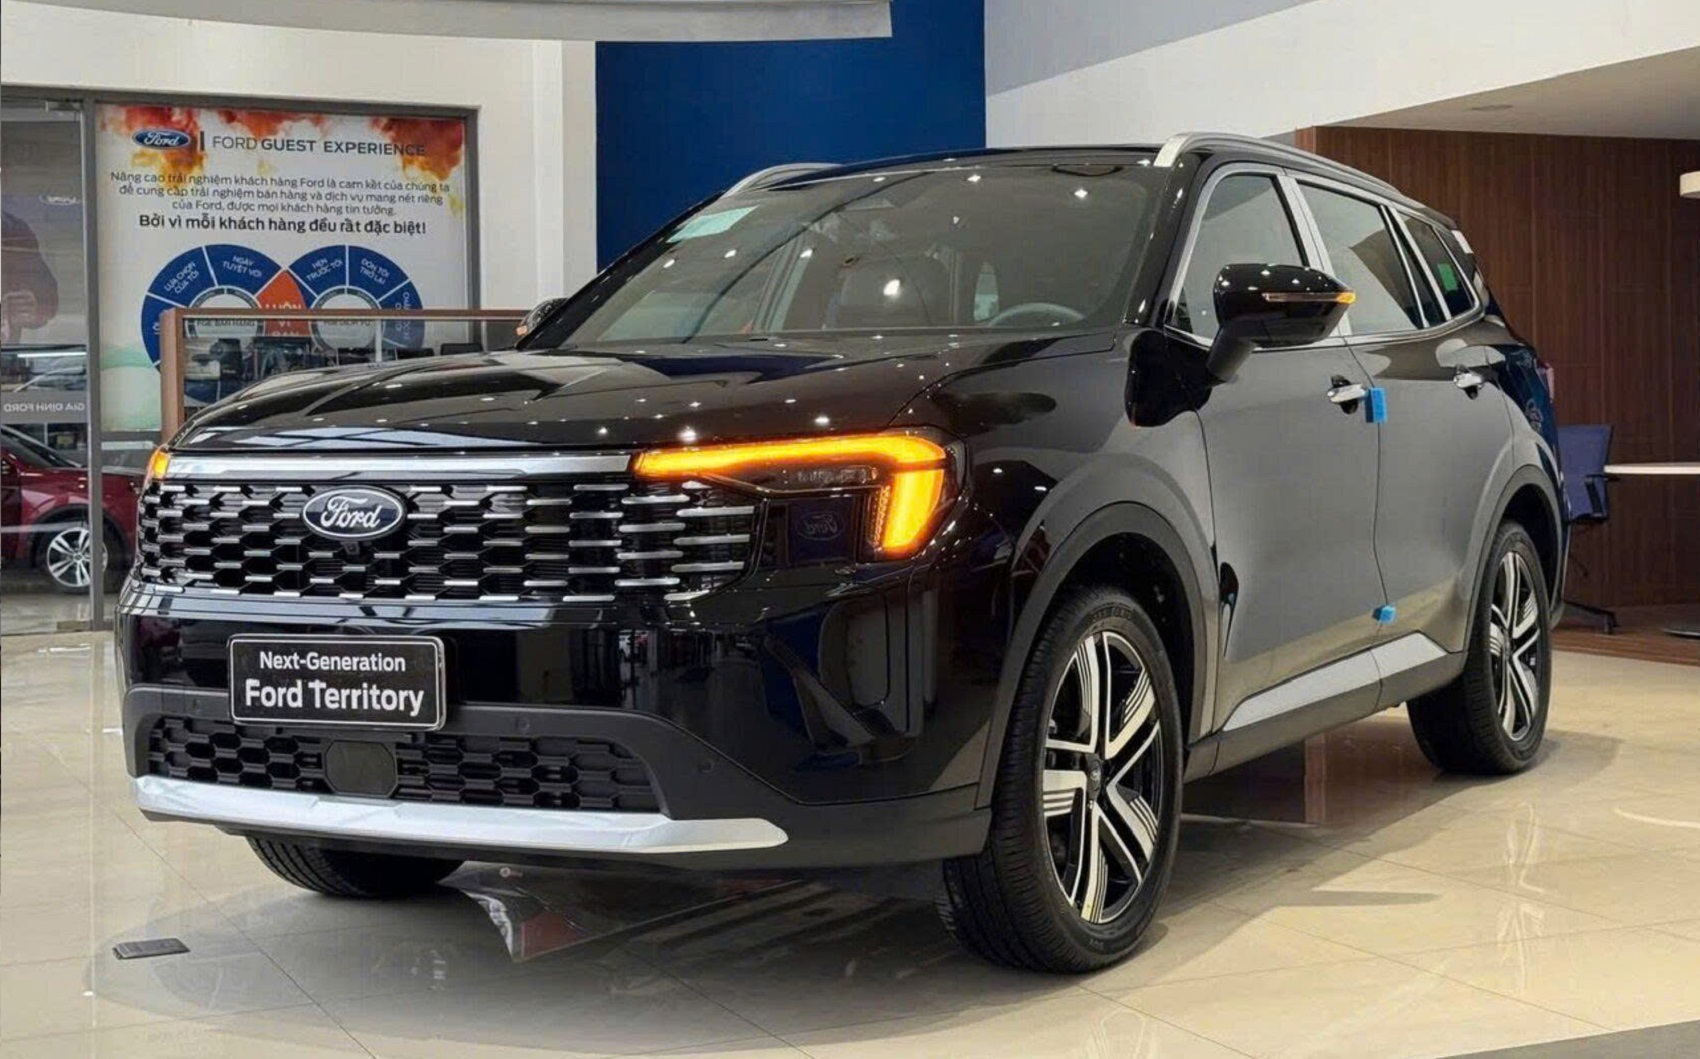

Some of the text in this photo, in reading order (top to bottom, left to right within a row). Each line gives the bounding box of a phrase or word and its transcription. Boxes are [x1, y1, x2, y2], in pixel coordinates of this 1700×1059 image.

[144, 132, 179, 145] Ford
[213, 136, 425, 156] FORD GUEST EXPERIENCE
[111, 172, 141, 183] Nâng
[144, 174, 165, 182] cao
[189, 175, 232, 186] nghiệm
[234, 176, 268, 185] khách
[270, 177, 297, 188] hàng
[301, 178, 324, 187] Ford
[327, 178, 336, 188] là
[339, 181, 363, 189] cam
[384, 180, 403, 190] của
[405, 182, 437, 193] chúng
[439, 184, 449, 192] ta
[120, 182, 133, 195] để
[137, 186, 164, 197] cung
[213, 188, 254, 199] nghiệm
[257, 189, 278, 198] bán
[280, 190, 307, 201] hàng
[310, 192, 322, 200] và
[325, 191, 347, 202] dịch
[350, 194, 363, 202] vụ
[366, 194, 396, 204] mang
[398, 194, 415, 203] nét
[172, 200, 193, 209] của
[227, 201, 254, 212] được
[258, 203, 278, 212] mọi
[281, 202, 313, 212] khách
[316, 204, 342, 215] hàng
[346, 206, 360, 214] tin
[140, 212, 426, 236] Bởi vì mỗi khách hàng đều rất đặc biệt!
[320, 496, 382, 528] Ford
[260, 652, 406, 672] Next-Generation
[245, 679, 424, 716] Ford Territory
